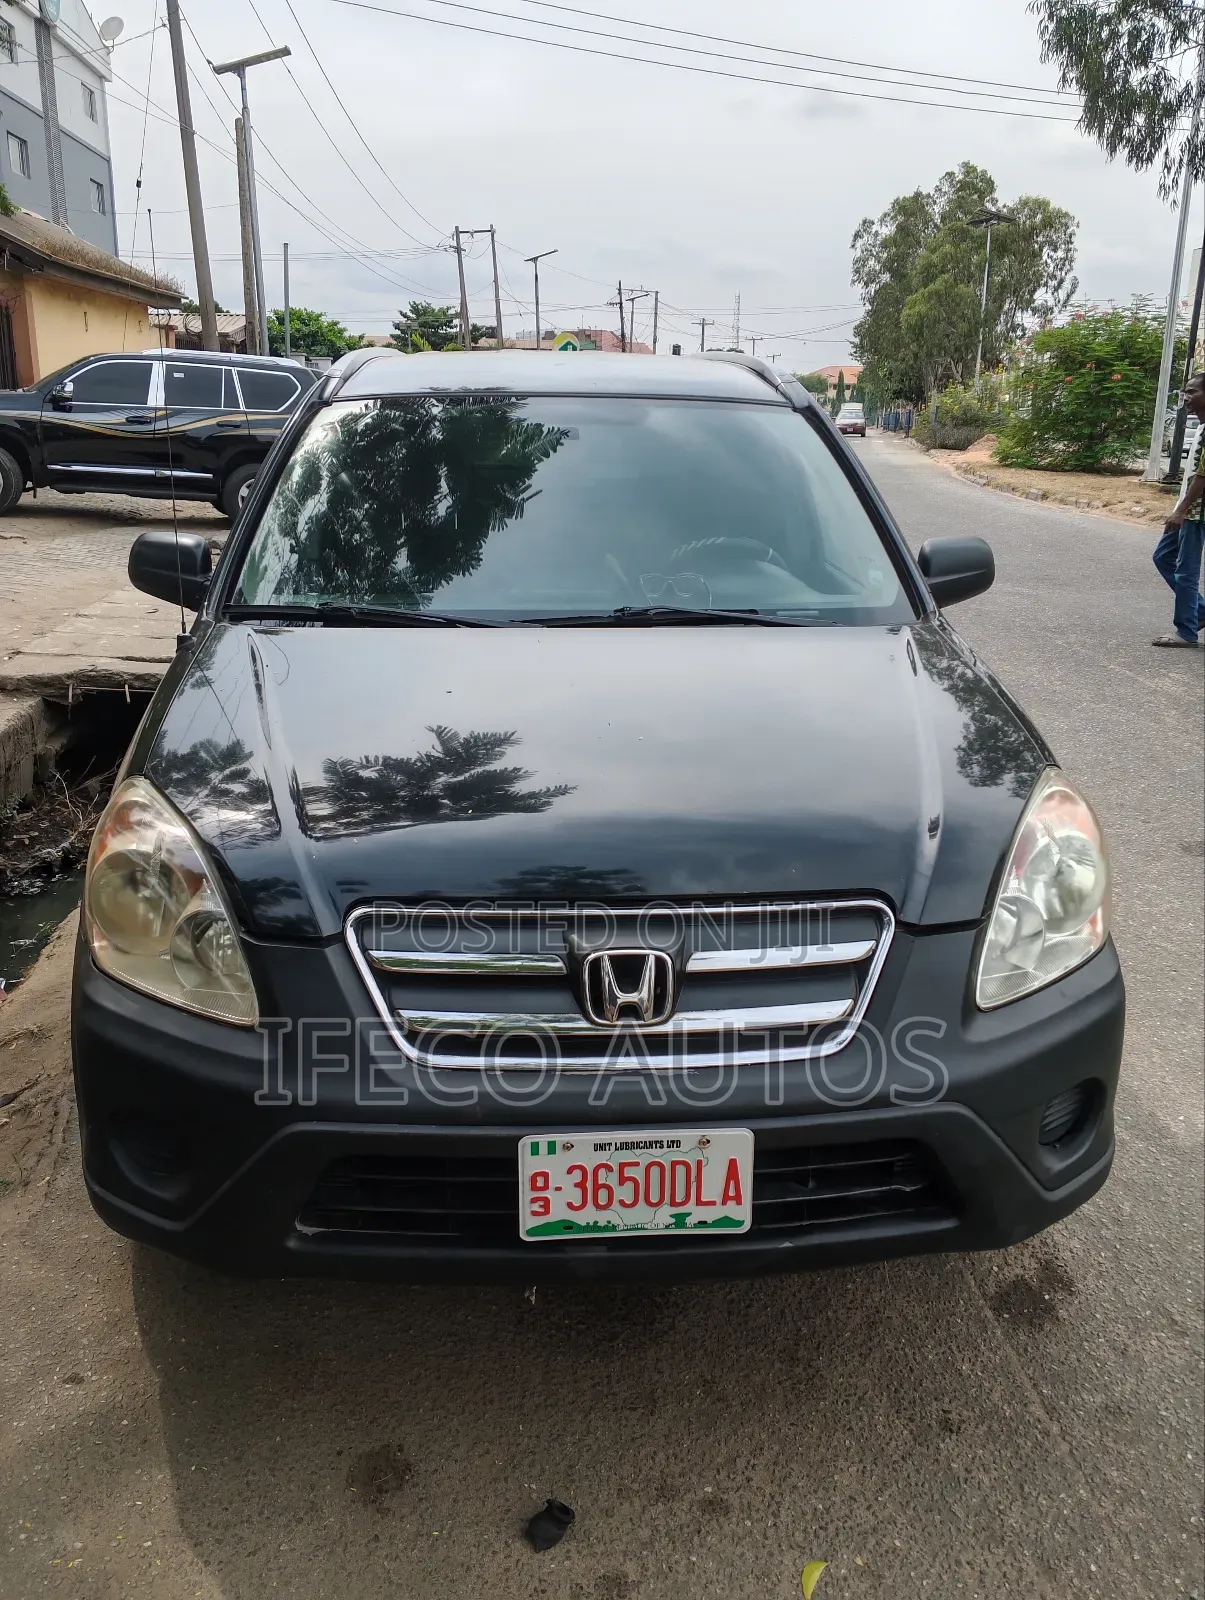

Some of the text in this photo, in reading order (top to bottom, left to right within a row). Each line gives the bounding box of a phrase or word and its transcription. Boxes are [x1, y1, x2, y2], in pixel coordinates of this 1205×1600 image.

[593, 1139, 682, 1152] UNIT LUBRICANTS LTD
